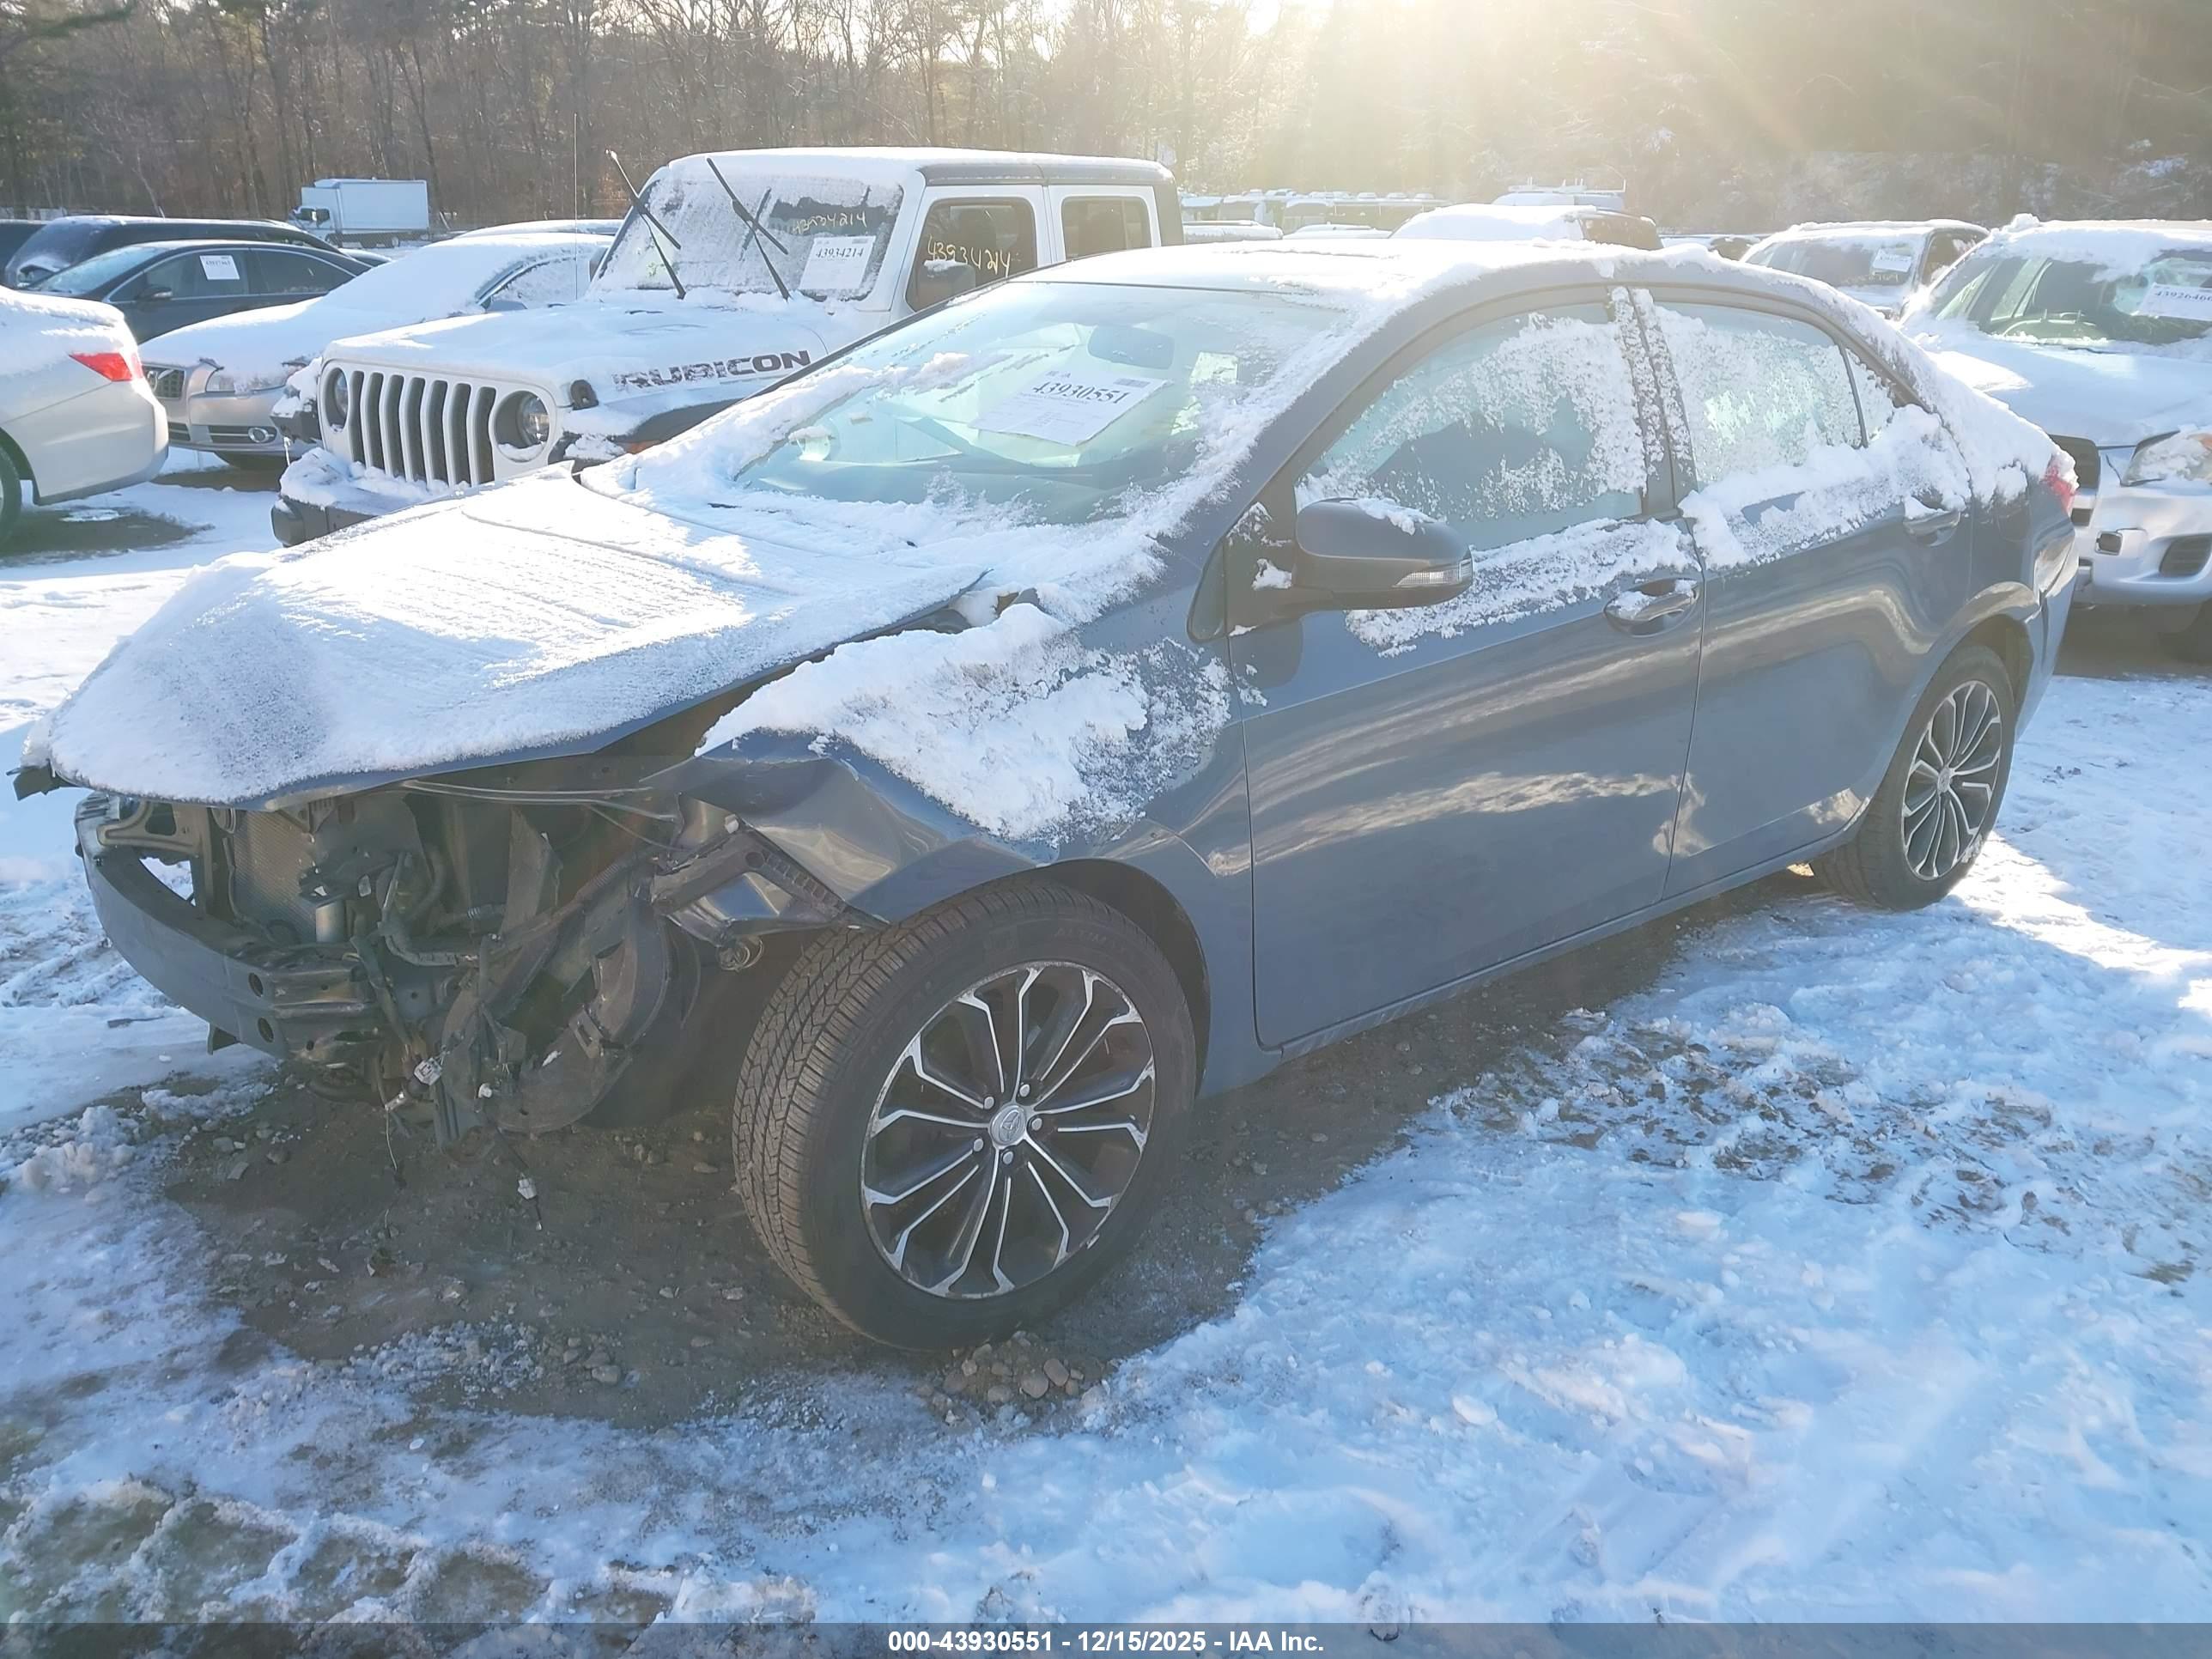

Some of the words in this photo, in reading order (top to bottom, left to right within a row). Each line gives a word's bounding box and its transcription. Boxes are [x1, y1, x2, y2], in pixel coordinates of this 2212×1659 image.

[816, 247, 865, 258] 43934214
[927, 234, 1011, 278] 43934214
[611, 349, 811, 391] RUBICON
[1032, 380, 1131, 404] 43930551
